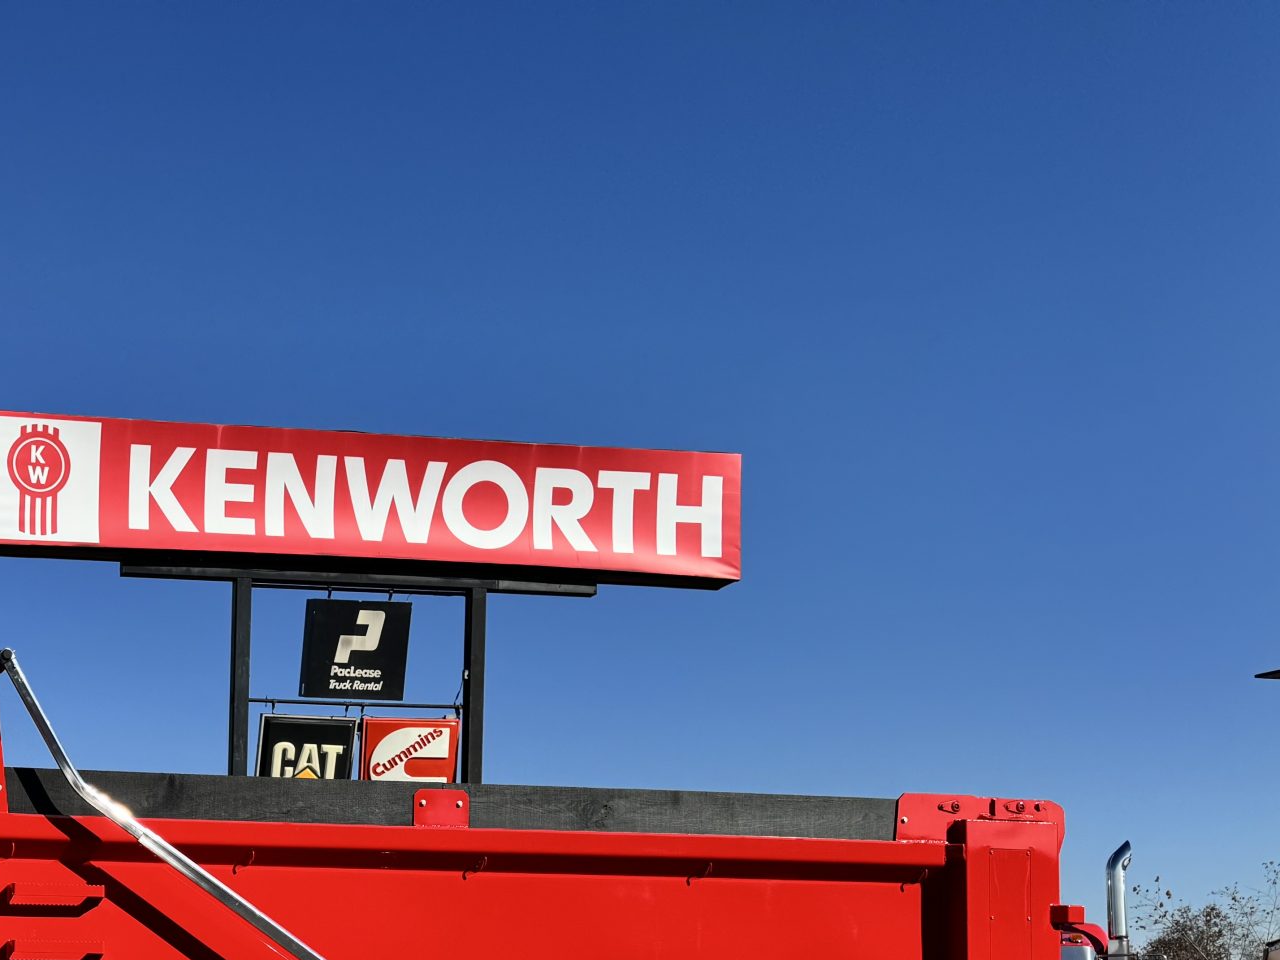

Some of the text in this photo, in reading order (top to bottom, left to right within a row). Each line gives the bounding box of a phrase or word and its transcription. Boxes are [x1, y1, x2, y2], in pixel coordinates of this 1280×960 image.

[30, 445, 46, 464] K
[27, 465, 50, 485] W
[128, 443, 724, 559] KENWORTH
[330, 665, 382, 678] PacLease
[329, 679, 383, 691] Truck Rental
[272, 741, 344, 779] CAT
[371, 728, 443, 777] Cummins
